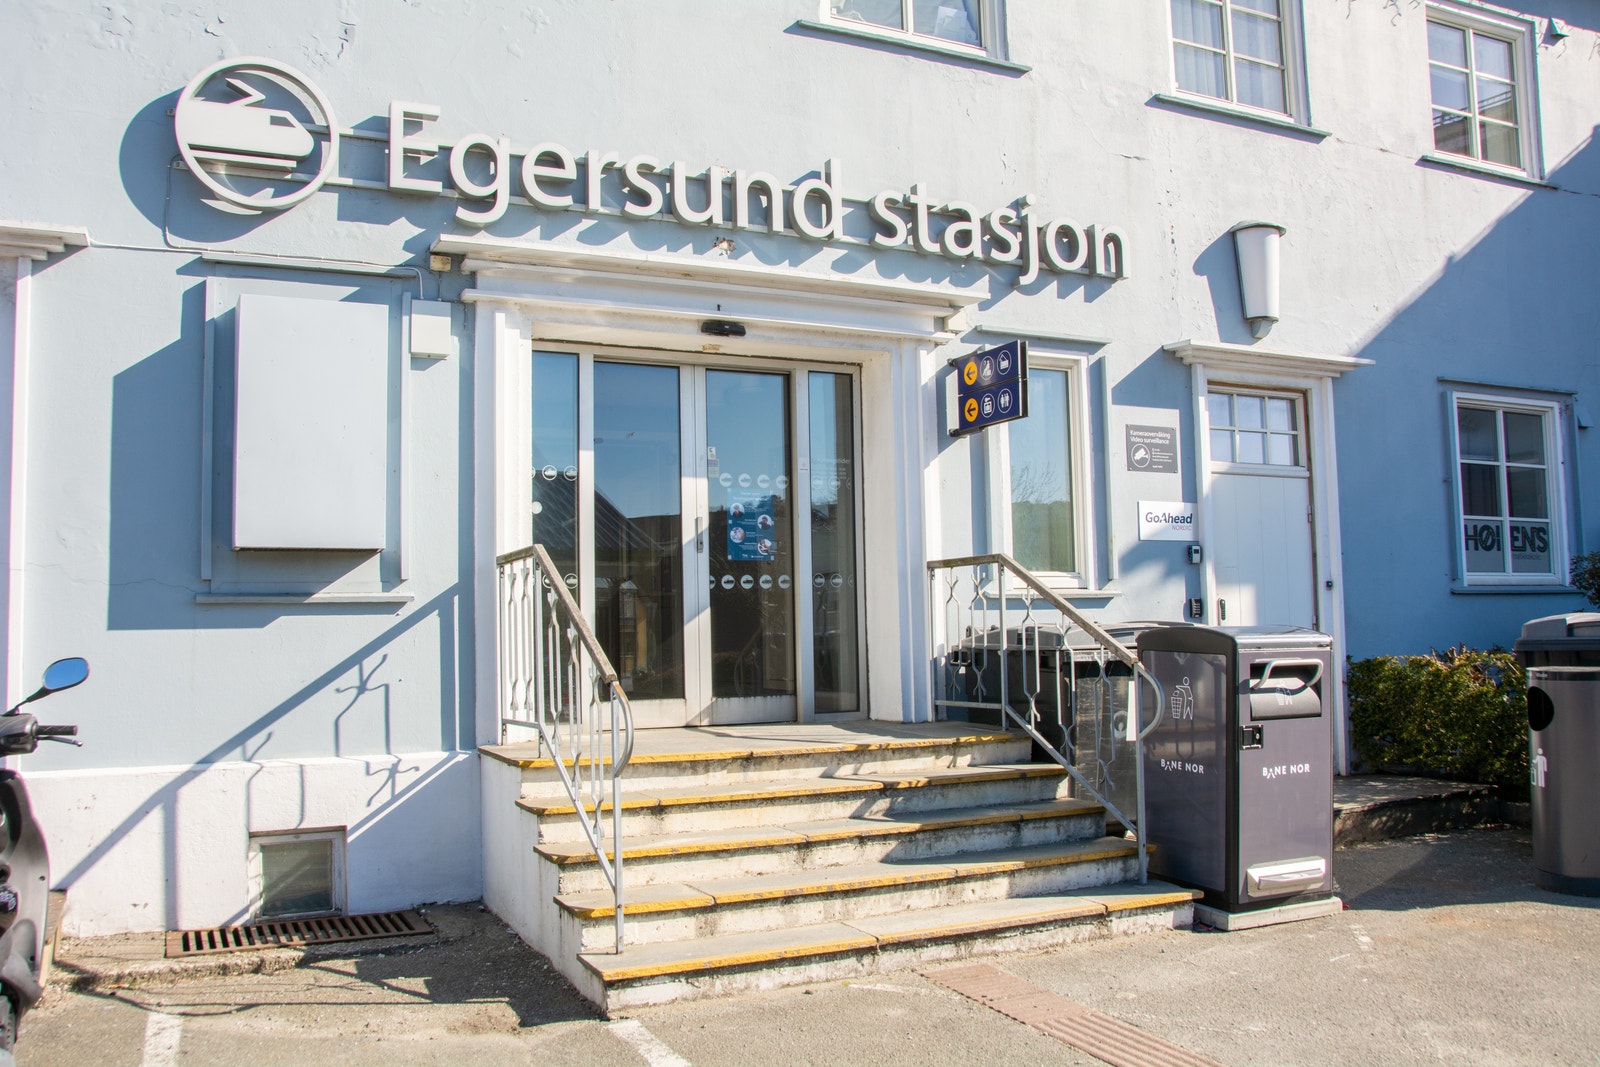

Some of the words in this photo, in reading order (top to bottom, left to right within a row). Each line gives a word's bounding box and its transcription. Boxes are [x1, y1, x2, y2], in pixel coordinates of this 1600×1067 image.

[388, 100, 838, 240] Egersund
[870, 182, 1131, 286] stasjon
[1185, 762, 1205, 774] NOR
[1289, 763, 1311, 774] NOR
